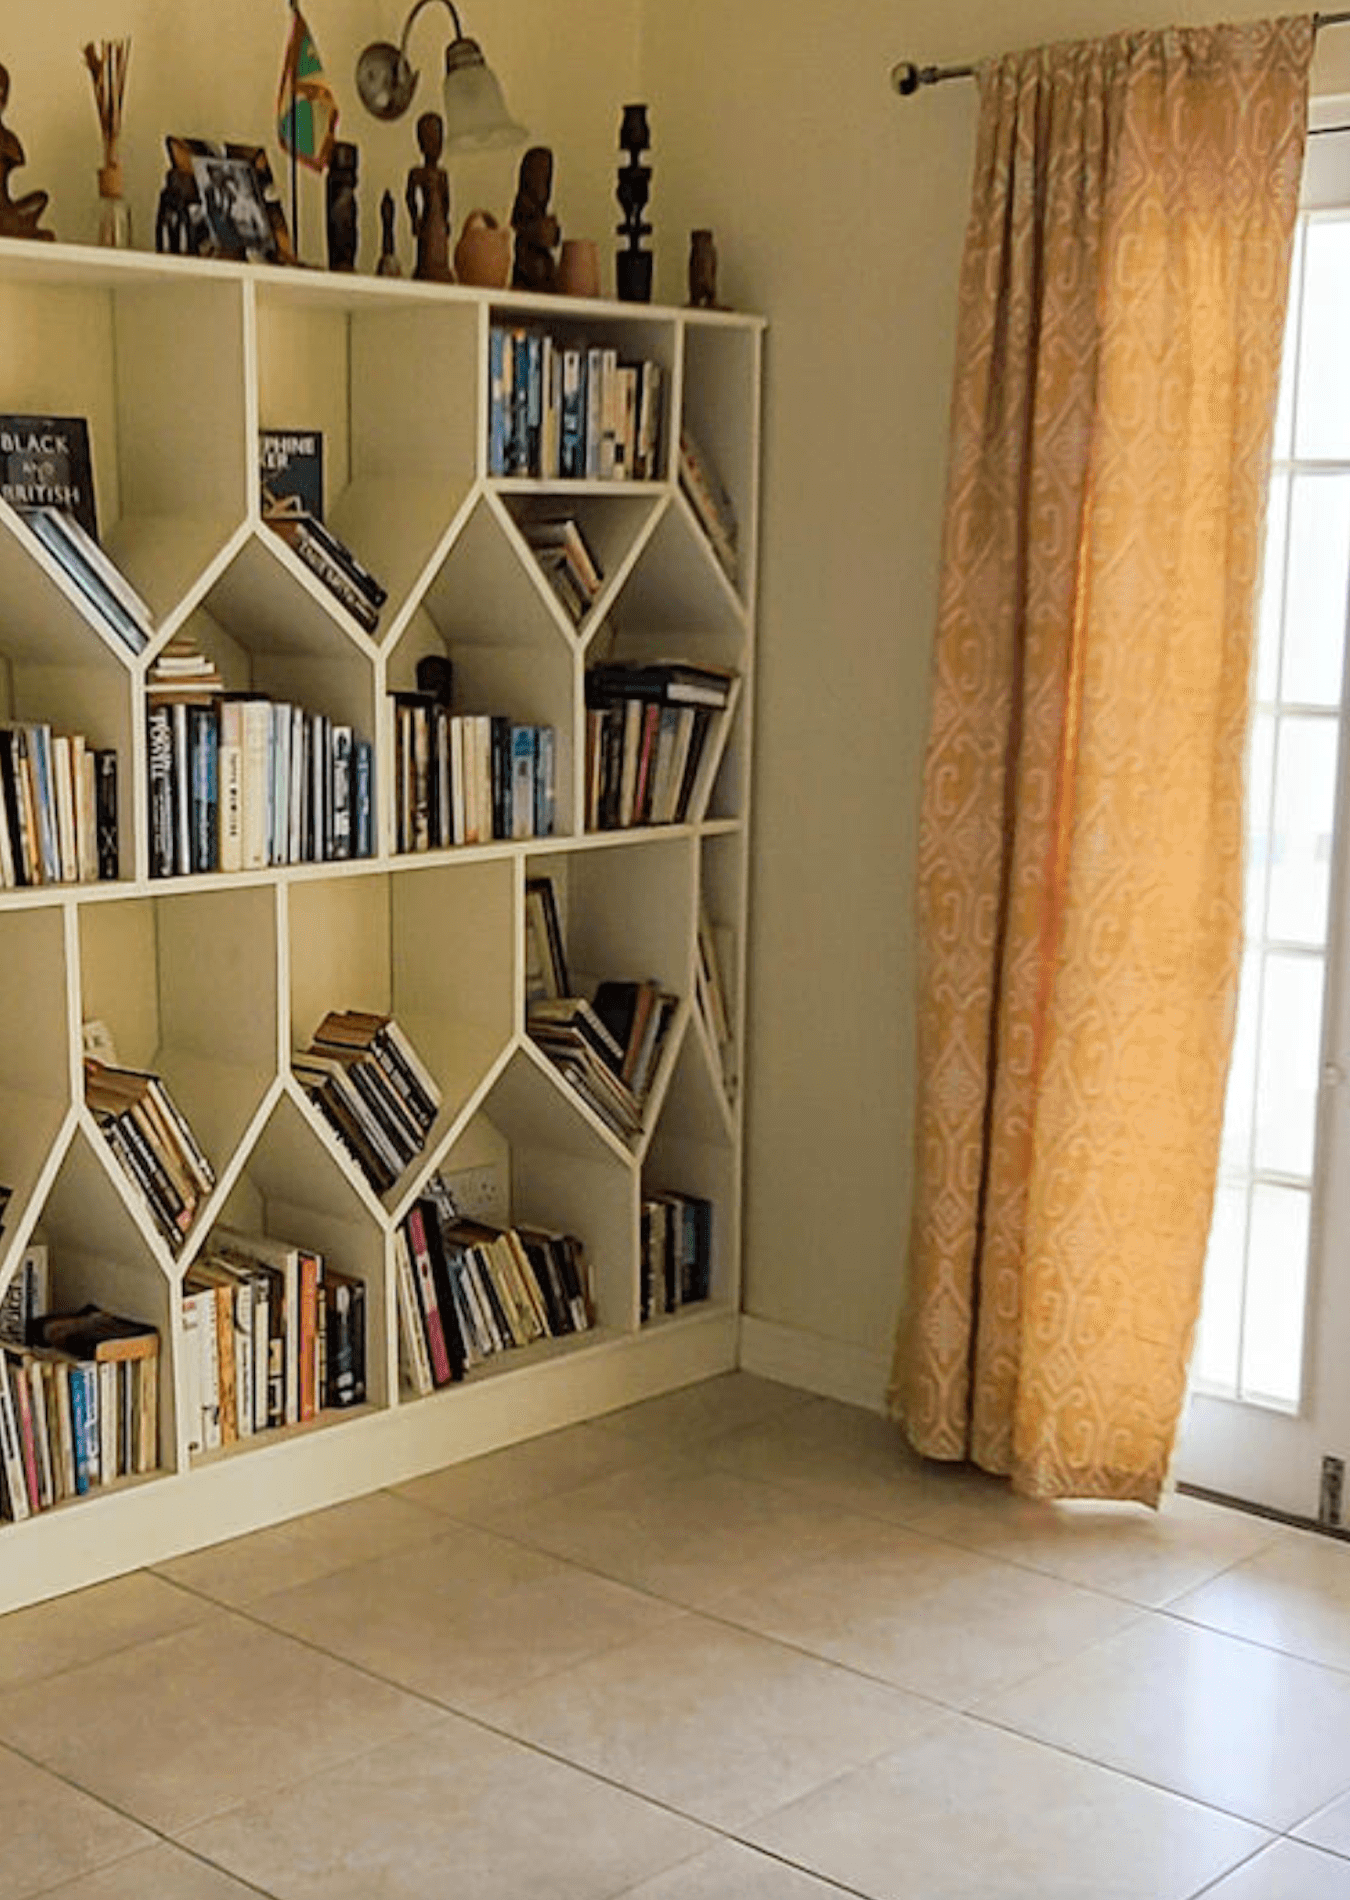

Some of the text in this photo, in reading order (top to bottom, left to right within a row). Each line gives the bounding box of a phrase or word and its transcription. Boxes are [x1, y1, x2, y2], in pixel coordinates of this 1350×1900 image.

[0, 432, 69, 454] BLACK
[261, 434, 316, 456] PHINE
[1, 483, 81, 503] BRITISH
